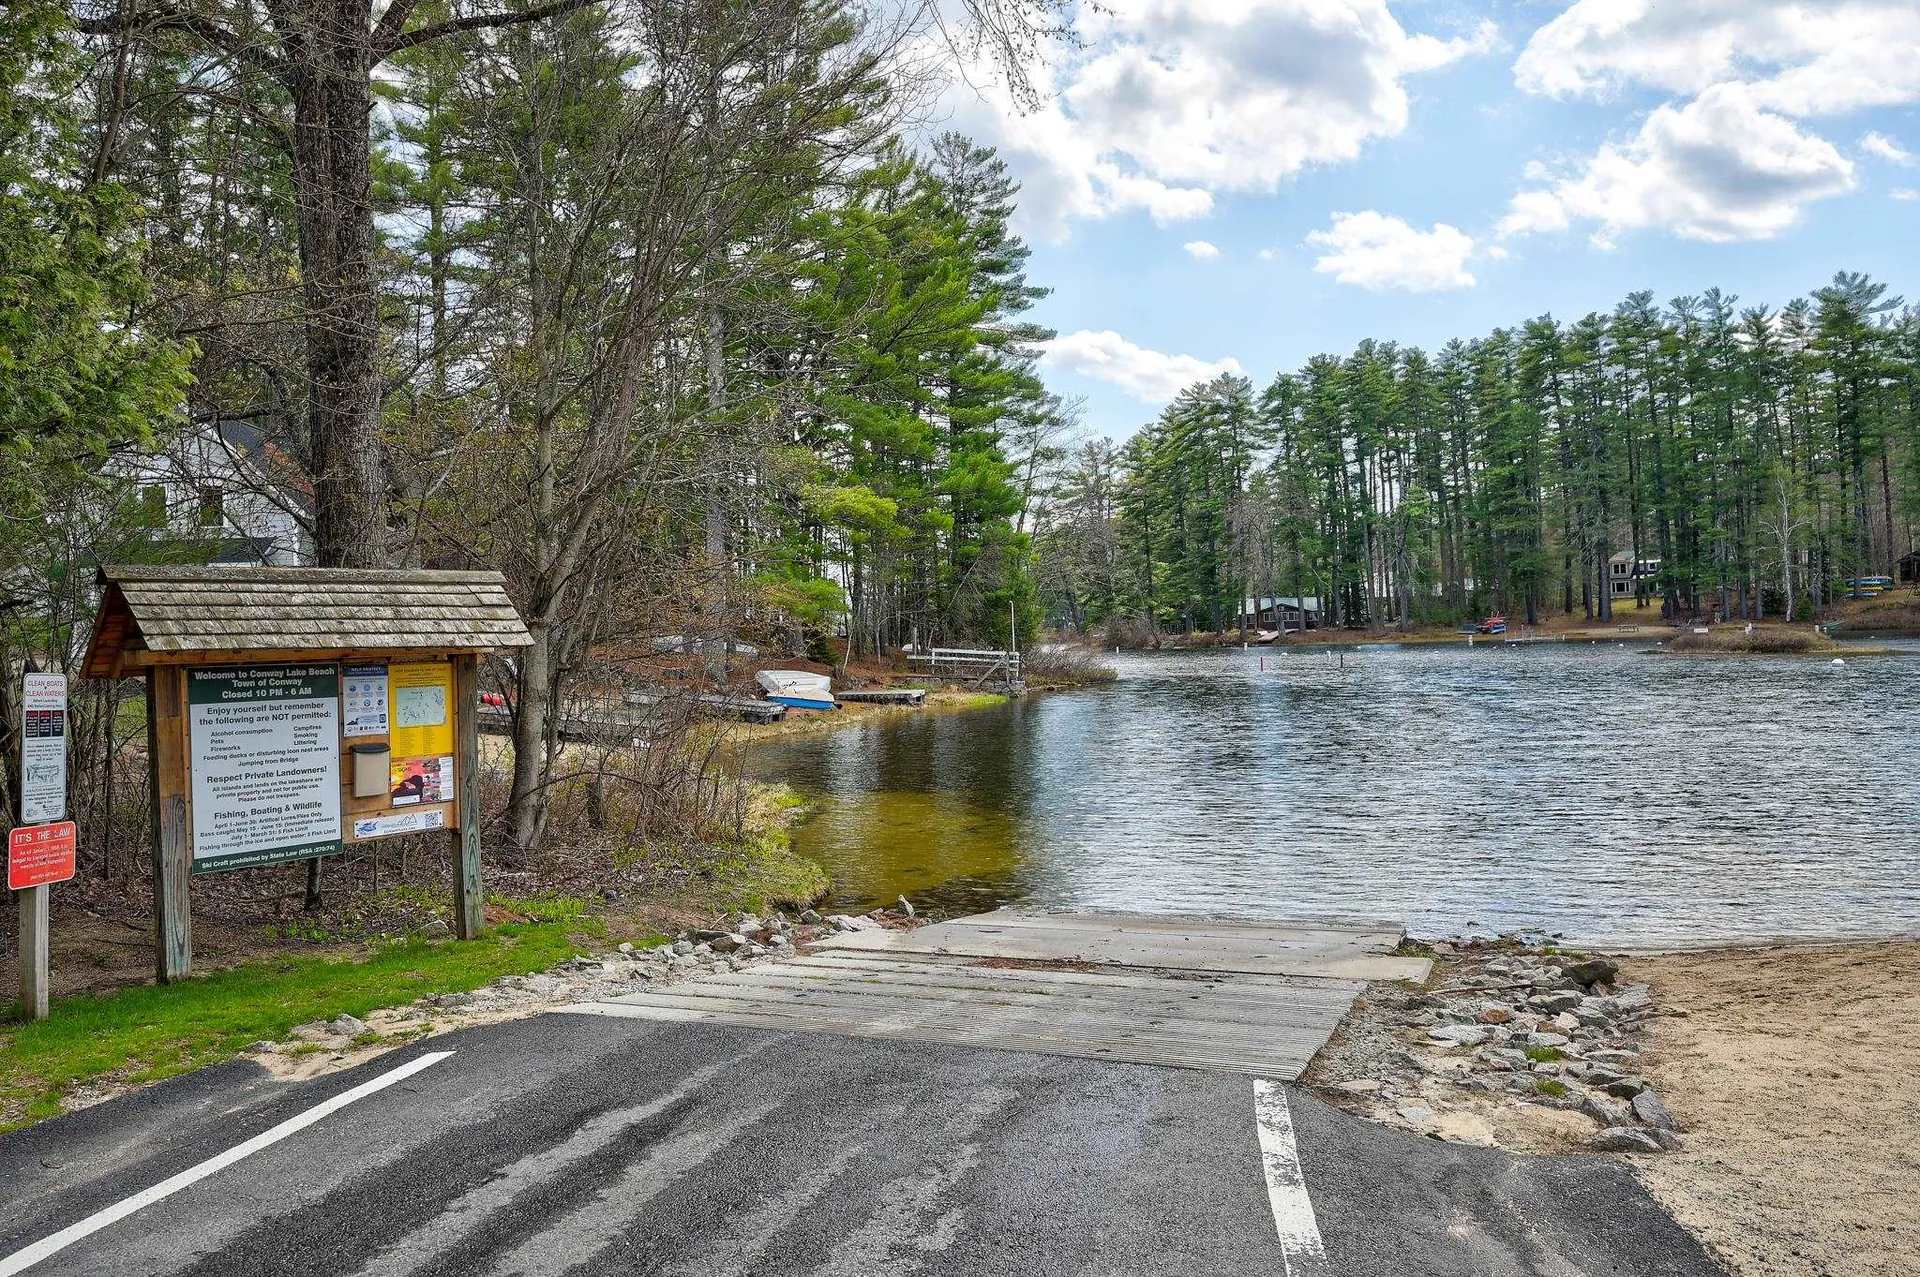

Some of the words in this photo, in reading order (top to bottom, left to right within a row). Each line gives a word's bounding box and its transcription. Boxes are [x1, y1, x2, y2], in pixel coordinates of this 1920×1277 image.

[194, 671, 236, 680] Welcome
[250, 670, 284, 679] Conway
[286, 668, 306, 676] Lake
[308, 668, 335, 676] Beach
[232, 680, 256, 688] Town
[268, 678, 302, 686] Conway
[222, 690, 252, 698] Closed
[298, 687, 312, 695] AM
[207, 706, 230, 716] Enjoy
[232, 704, 266, 714] yourself
[284, 702, 324, 710] remember
[216, 716, 254, 724] following
[272, 713, 290, 721] NOT
[291, 711, 332, 721] permitted:
[256, 749, 286, 757] disturbing
[206, 774, 242, 784] Respect
[245, 771, 274, 780] Private
[276, 766, 328, 777] Landowners!
[214, 810, 248, 820] Fishing,
[250, 806, 282, 816] Boating
[292, 802, 322, 811] Wildlife
[15, 833, 32, 844] IT'S
[37, 831, 50, 840] THE
[216, 828, 236, 836] caught
[222, 841, 244, 849] through
[213, 859, 229, 868] Craft
[230, 855, 260, 866] prohibited
[270, 851, 285, 859] State
